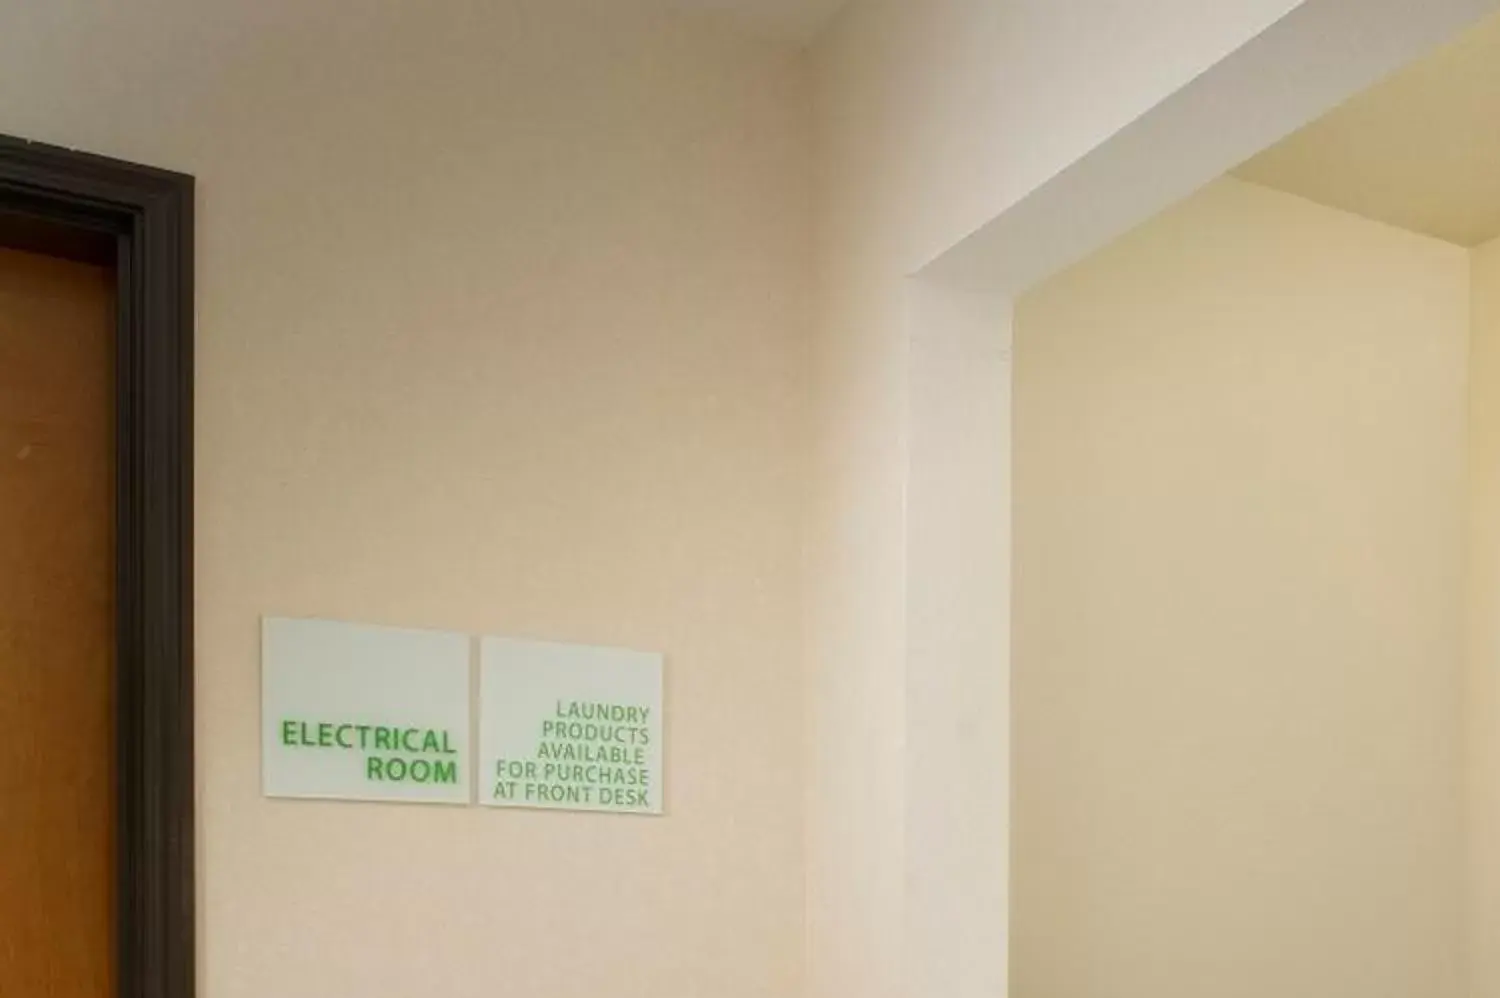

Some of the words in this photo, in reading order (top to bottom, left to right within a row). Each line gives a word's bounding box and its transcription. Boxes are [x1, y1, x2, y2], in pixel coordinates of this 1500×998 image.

[556, 701, 649, 724] LAUNDRY
[283, 720, 457, 753] ELECTRICAL
[543, 720, 649, 745] PRODUCTS
[537, 742, 645, 765] AVAILABLE
[367, 756, 457, 784] ROOM
[496, 759, 536, 779] FOR
[544, 763, 649, 787] PURCHASE
[493, 781, 519, 799] AT
[525, 783, 593, 803] FRONT
[600, 787, 649, 807] DESK
